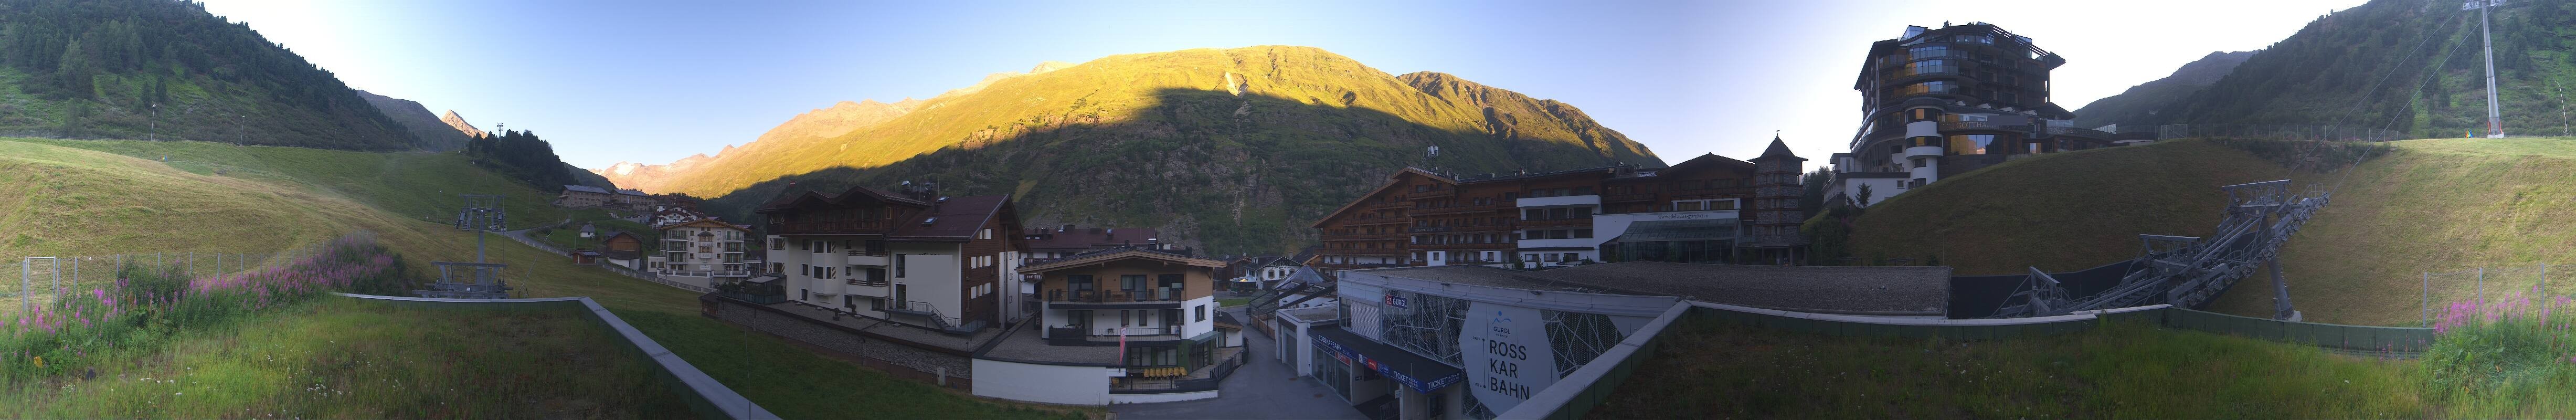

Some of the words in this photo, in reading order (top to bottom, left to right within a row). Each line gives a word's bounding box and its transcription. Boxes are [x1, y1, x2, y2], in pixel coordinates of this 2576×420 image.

[1393, 298, 1407, 307] GURGL
[1493, 326, 1511, 334] GURGL
[1318, 334, 1342, 352] ROSSKARBAHN
[1490, 339, 1527, 361] ROSS
[1490, 358, 1518, 379] KAR
[1393, 371, 1409, 383] TICKET
[1427, 377, 1447, 389] TICKET
[1490, 376, 1530, 400] BAHN
